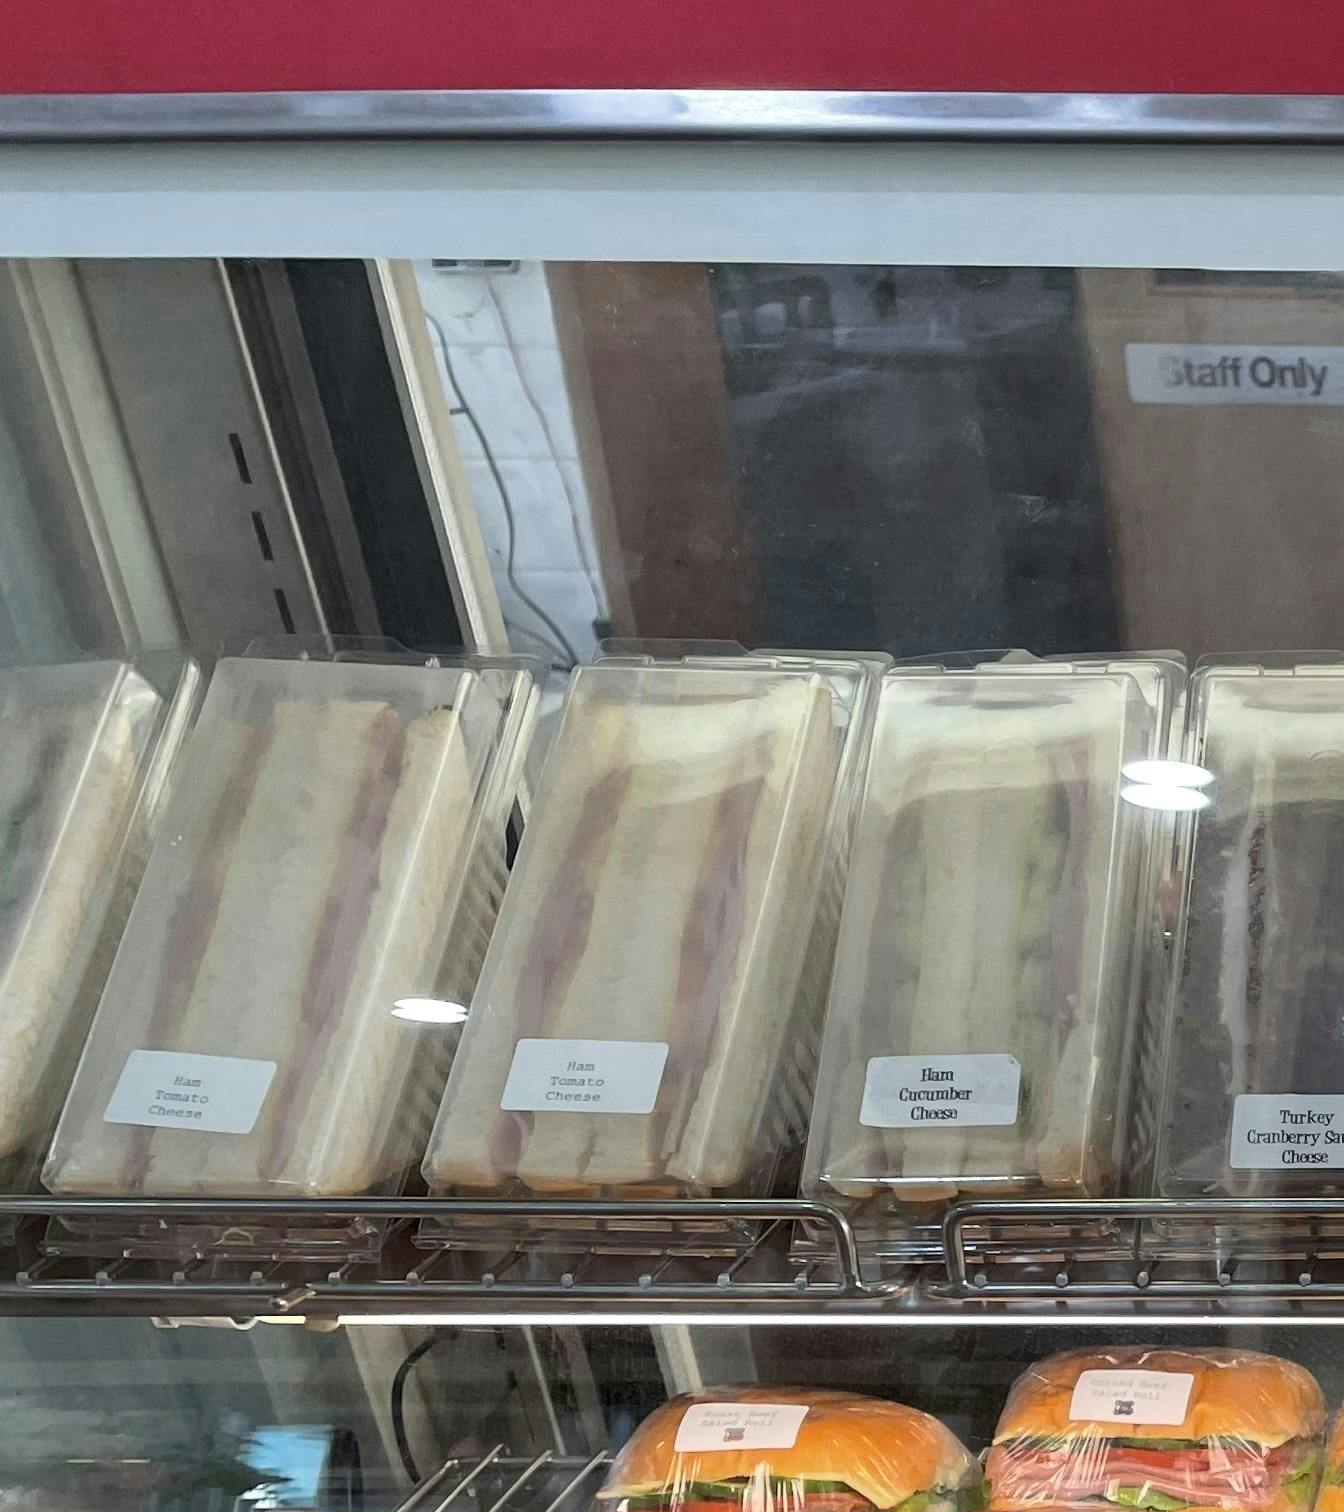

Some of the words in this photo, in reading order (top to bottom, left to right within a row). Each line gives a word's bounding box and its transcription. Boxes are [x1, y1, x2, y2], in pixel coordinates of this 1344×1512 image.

[1158, 356, 1241, 387] Staff
[1250, 356, 1328, 396] Only
[567, 1062, 594, 1071] Ham
[174, 1076, 202, 1087] Ham
[551, 1076, 604, 1087] Tomato
[921, 1068, 954, 1082] Ham
[155, 1089, 209, 1104] Tomato
[546, 1091, 601, 1102] Cheese
[899, 1089, 972, 1101] Cucumber
[148, 1105, 203, 1119] Cheese
[910, 1107, 958, 1120] Cheese
[1280, 1110, 1335, 1125] Turkey
[1247, 1131, 1319, 1146] Cranberry
[1282, 1150, 1329, 1164] Cheese
